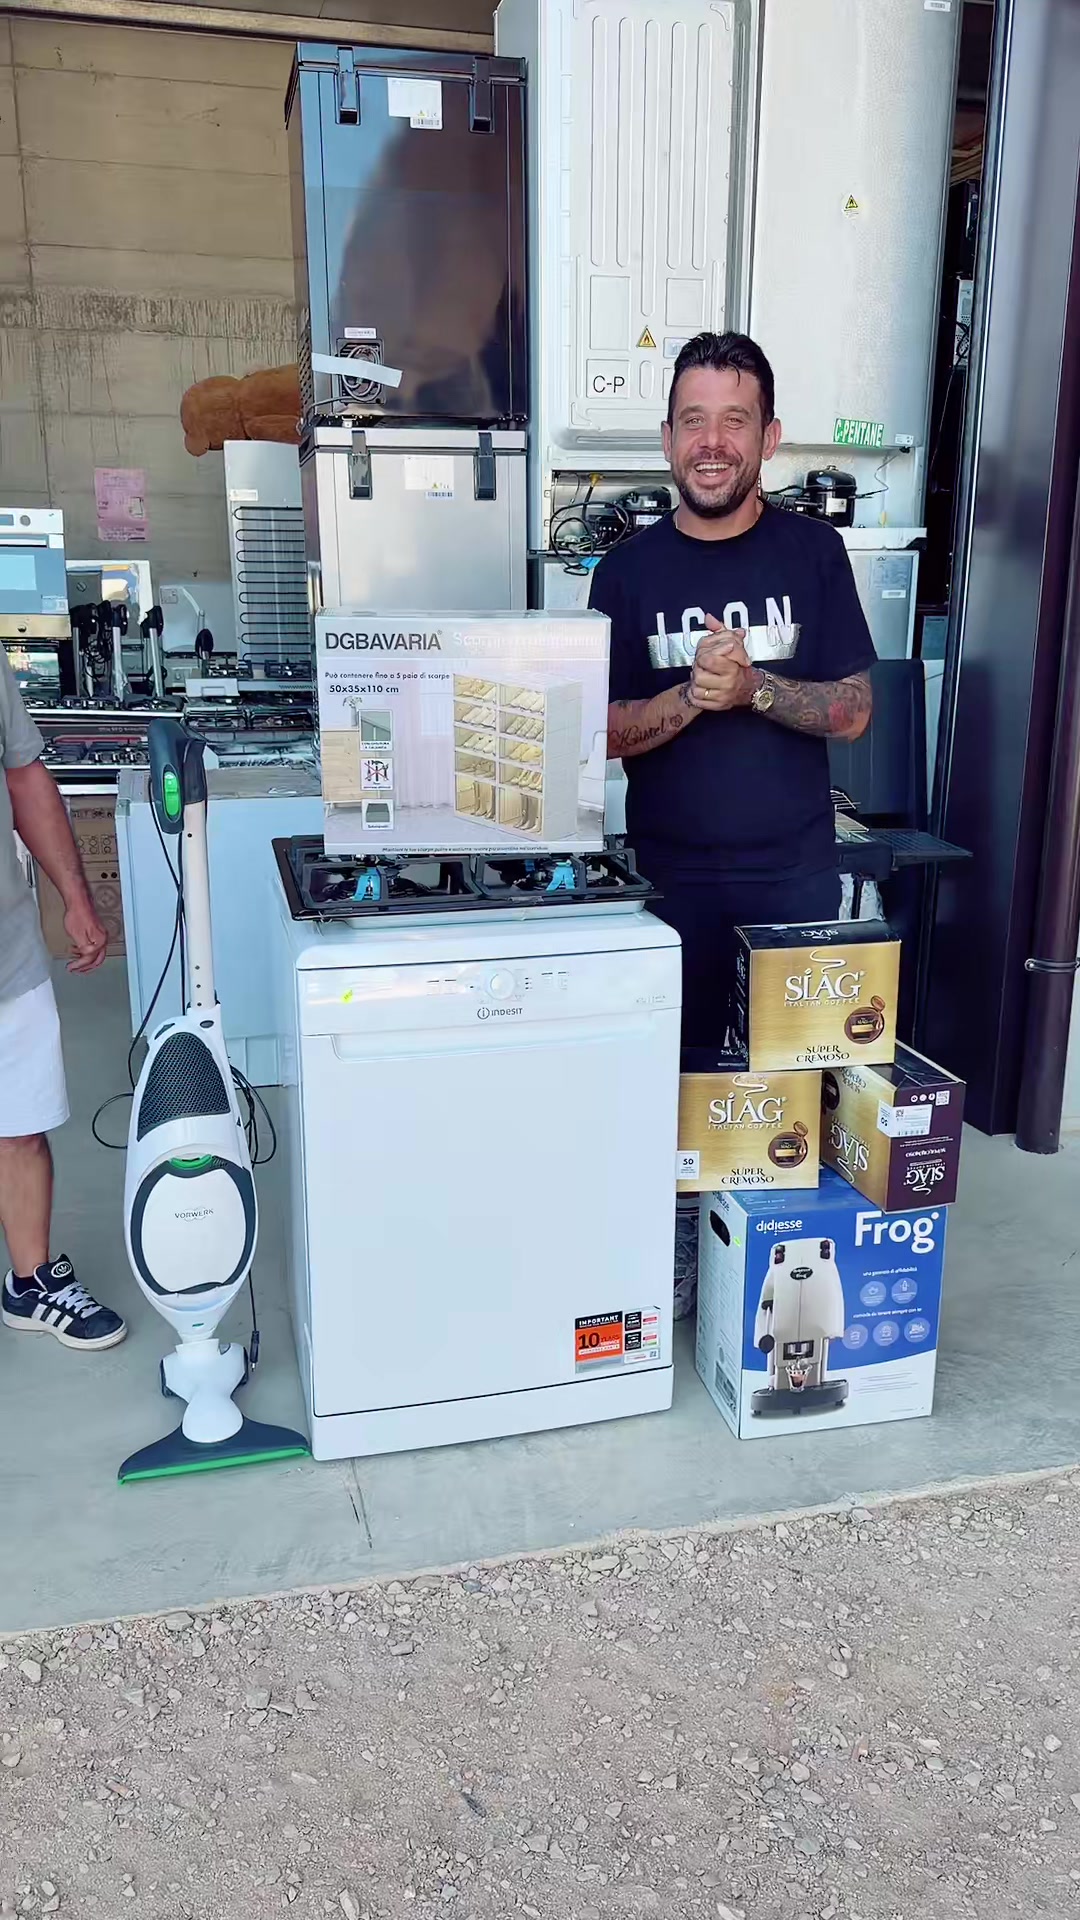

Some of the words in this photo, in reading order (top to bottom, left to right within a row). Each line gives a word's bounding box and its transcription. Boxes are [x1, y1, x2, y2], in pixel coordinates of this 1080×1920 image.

[593, 375, 626, 393] C-P
[835, 418, 884, 447] C-PENTANE
[375, 671, 388, 679] fino
[402, 672, 418, 680] paio
[329, 684, 383, 693] 50x35x110
[806, 1044, 841, 1054] SUPER
[796, 1052, 850, 1063] CREMOSO
[731, 1167, 765, 1177] SUPER
[721, 1175, 775, 1185] CREMOSO
[756, 1219, 803, 1235] didiesse
[855, 1211, 936, 1254] Frog
[579, 1315, 619, 1326] IMPORTANT
[578, 1332, 601, 1350] 10
